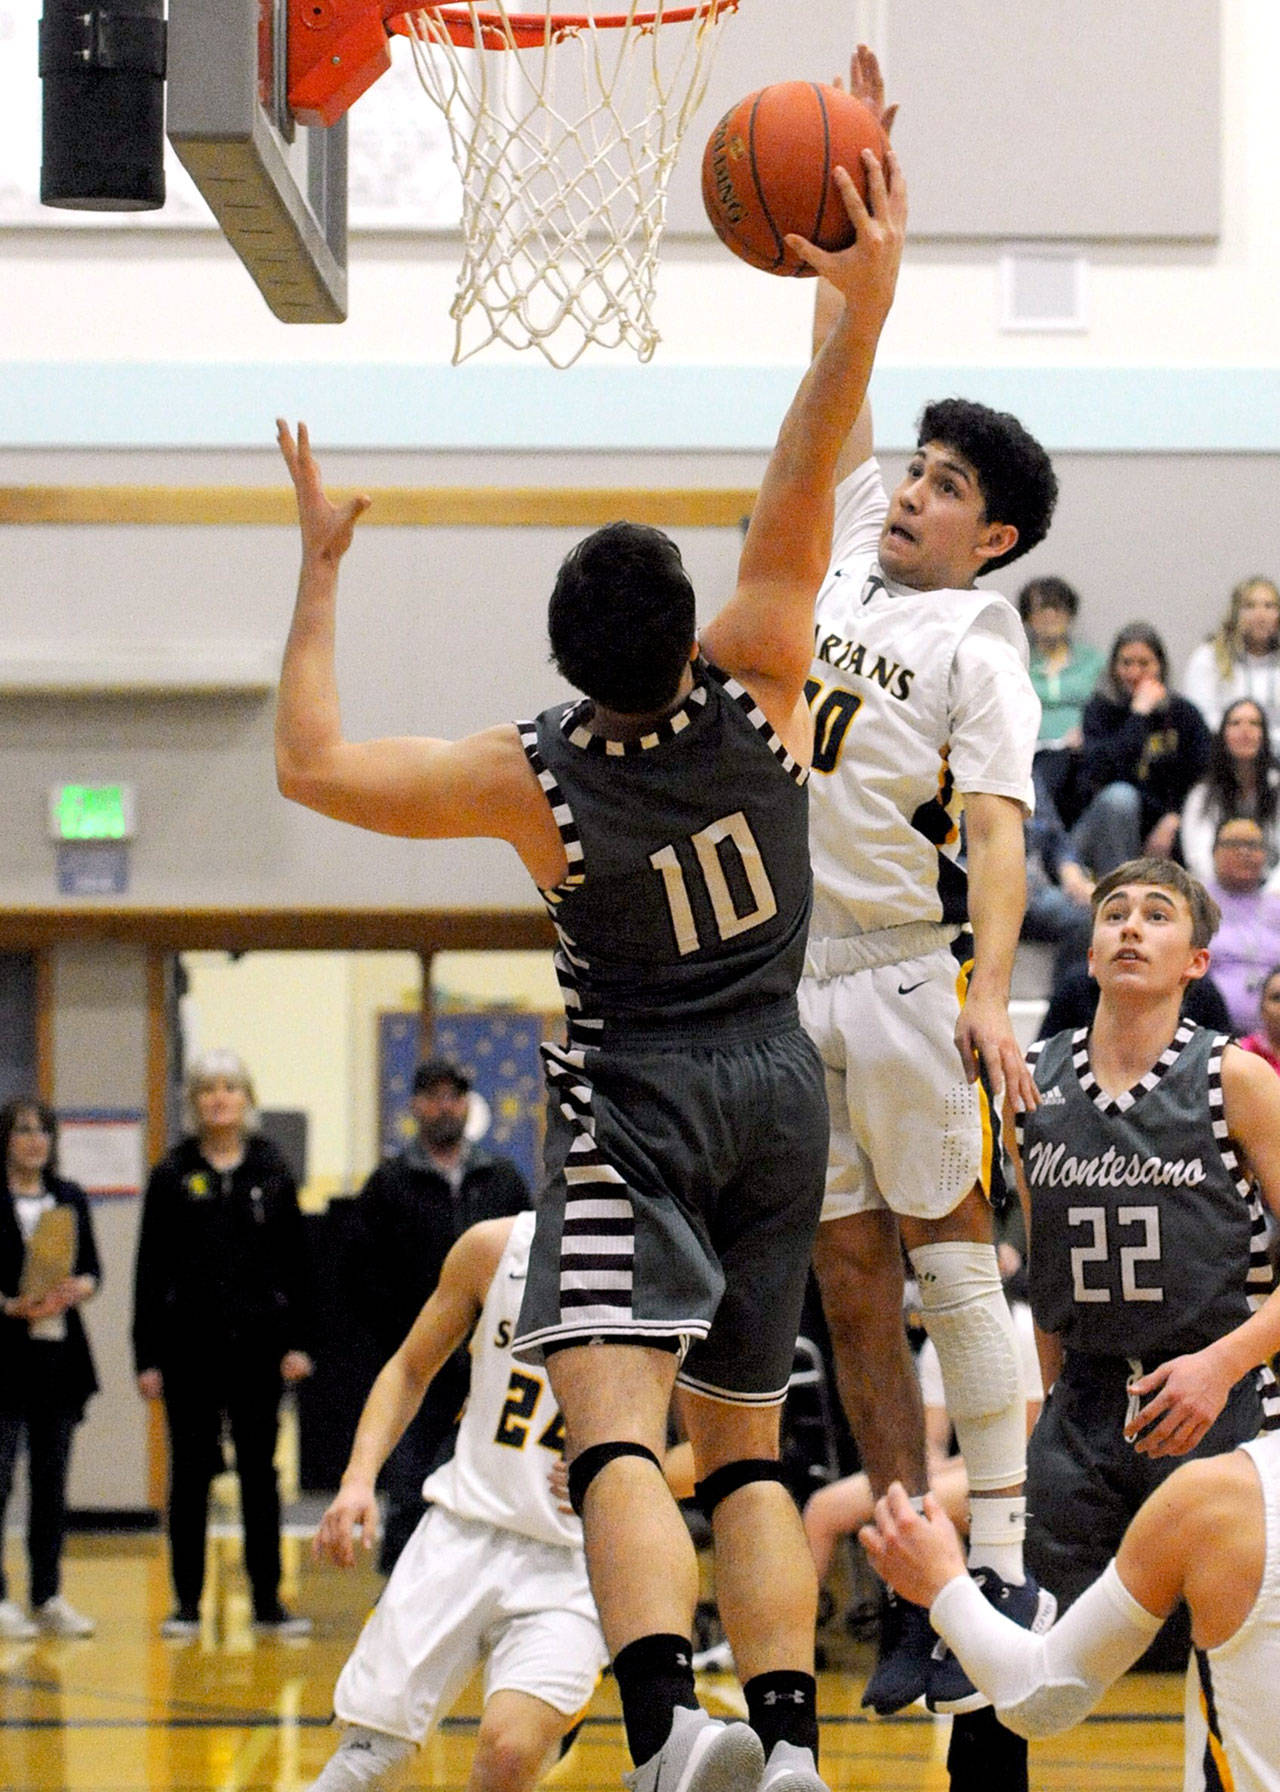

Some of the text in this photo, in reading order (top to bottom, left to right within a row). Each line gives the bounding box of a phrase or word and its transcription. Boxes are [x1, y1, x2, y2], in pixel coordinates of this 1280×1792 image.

[803, 674, 864, 776] 0
[648, 810, 779, 957] 10
[1028, 1141, 1208, 1188] Montesano
[1067, 1204, 1164, 1303] 22
